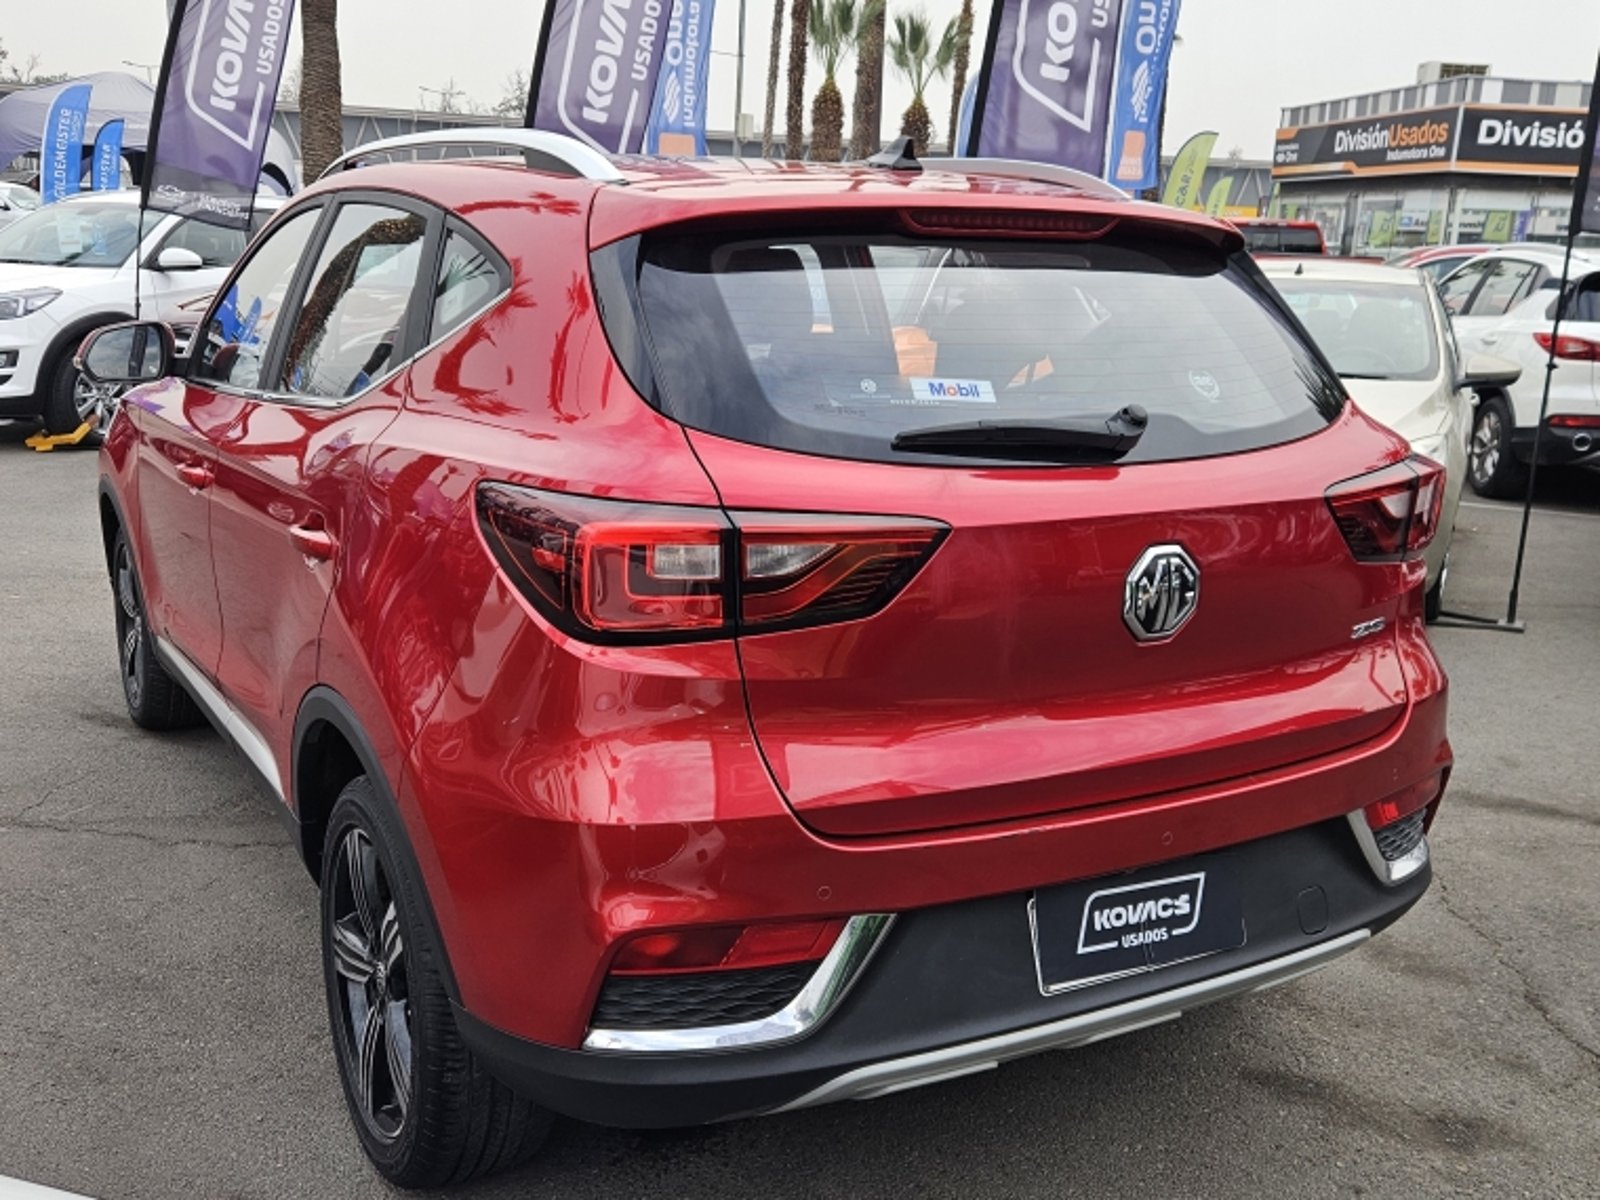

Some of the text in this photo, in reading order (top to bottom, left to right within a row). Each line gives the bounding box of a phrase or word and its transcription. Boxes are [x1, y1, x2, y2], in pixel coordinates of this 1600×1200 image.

[1477, 117, 1586, 149] Divisió
[927, 382, 981, 398] Mobil
[1134, 555, 1196, 634] MG
[1093, 893, 1191, 932] KOVACS
[1120, 926, 1169, 949] USADOS
